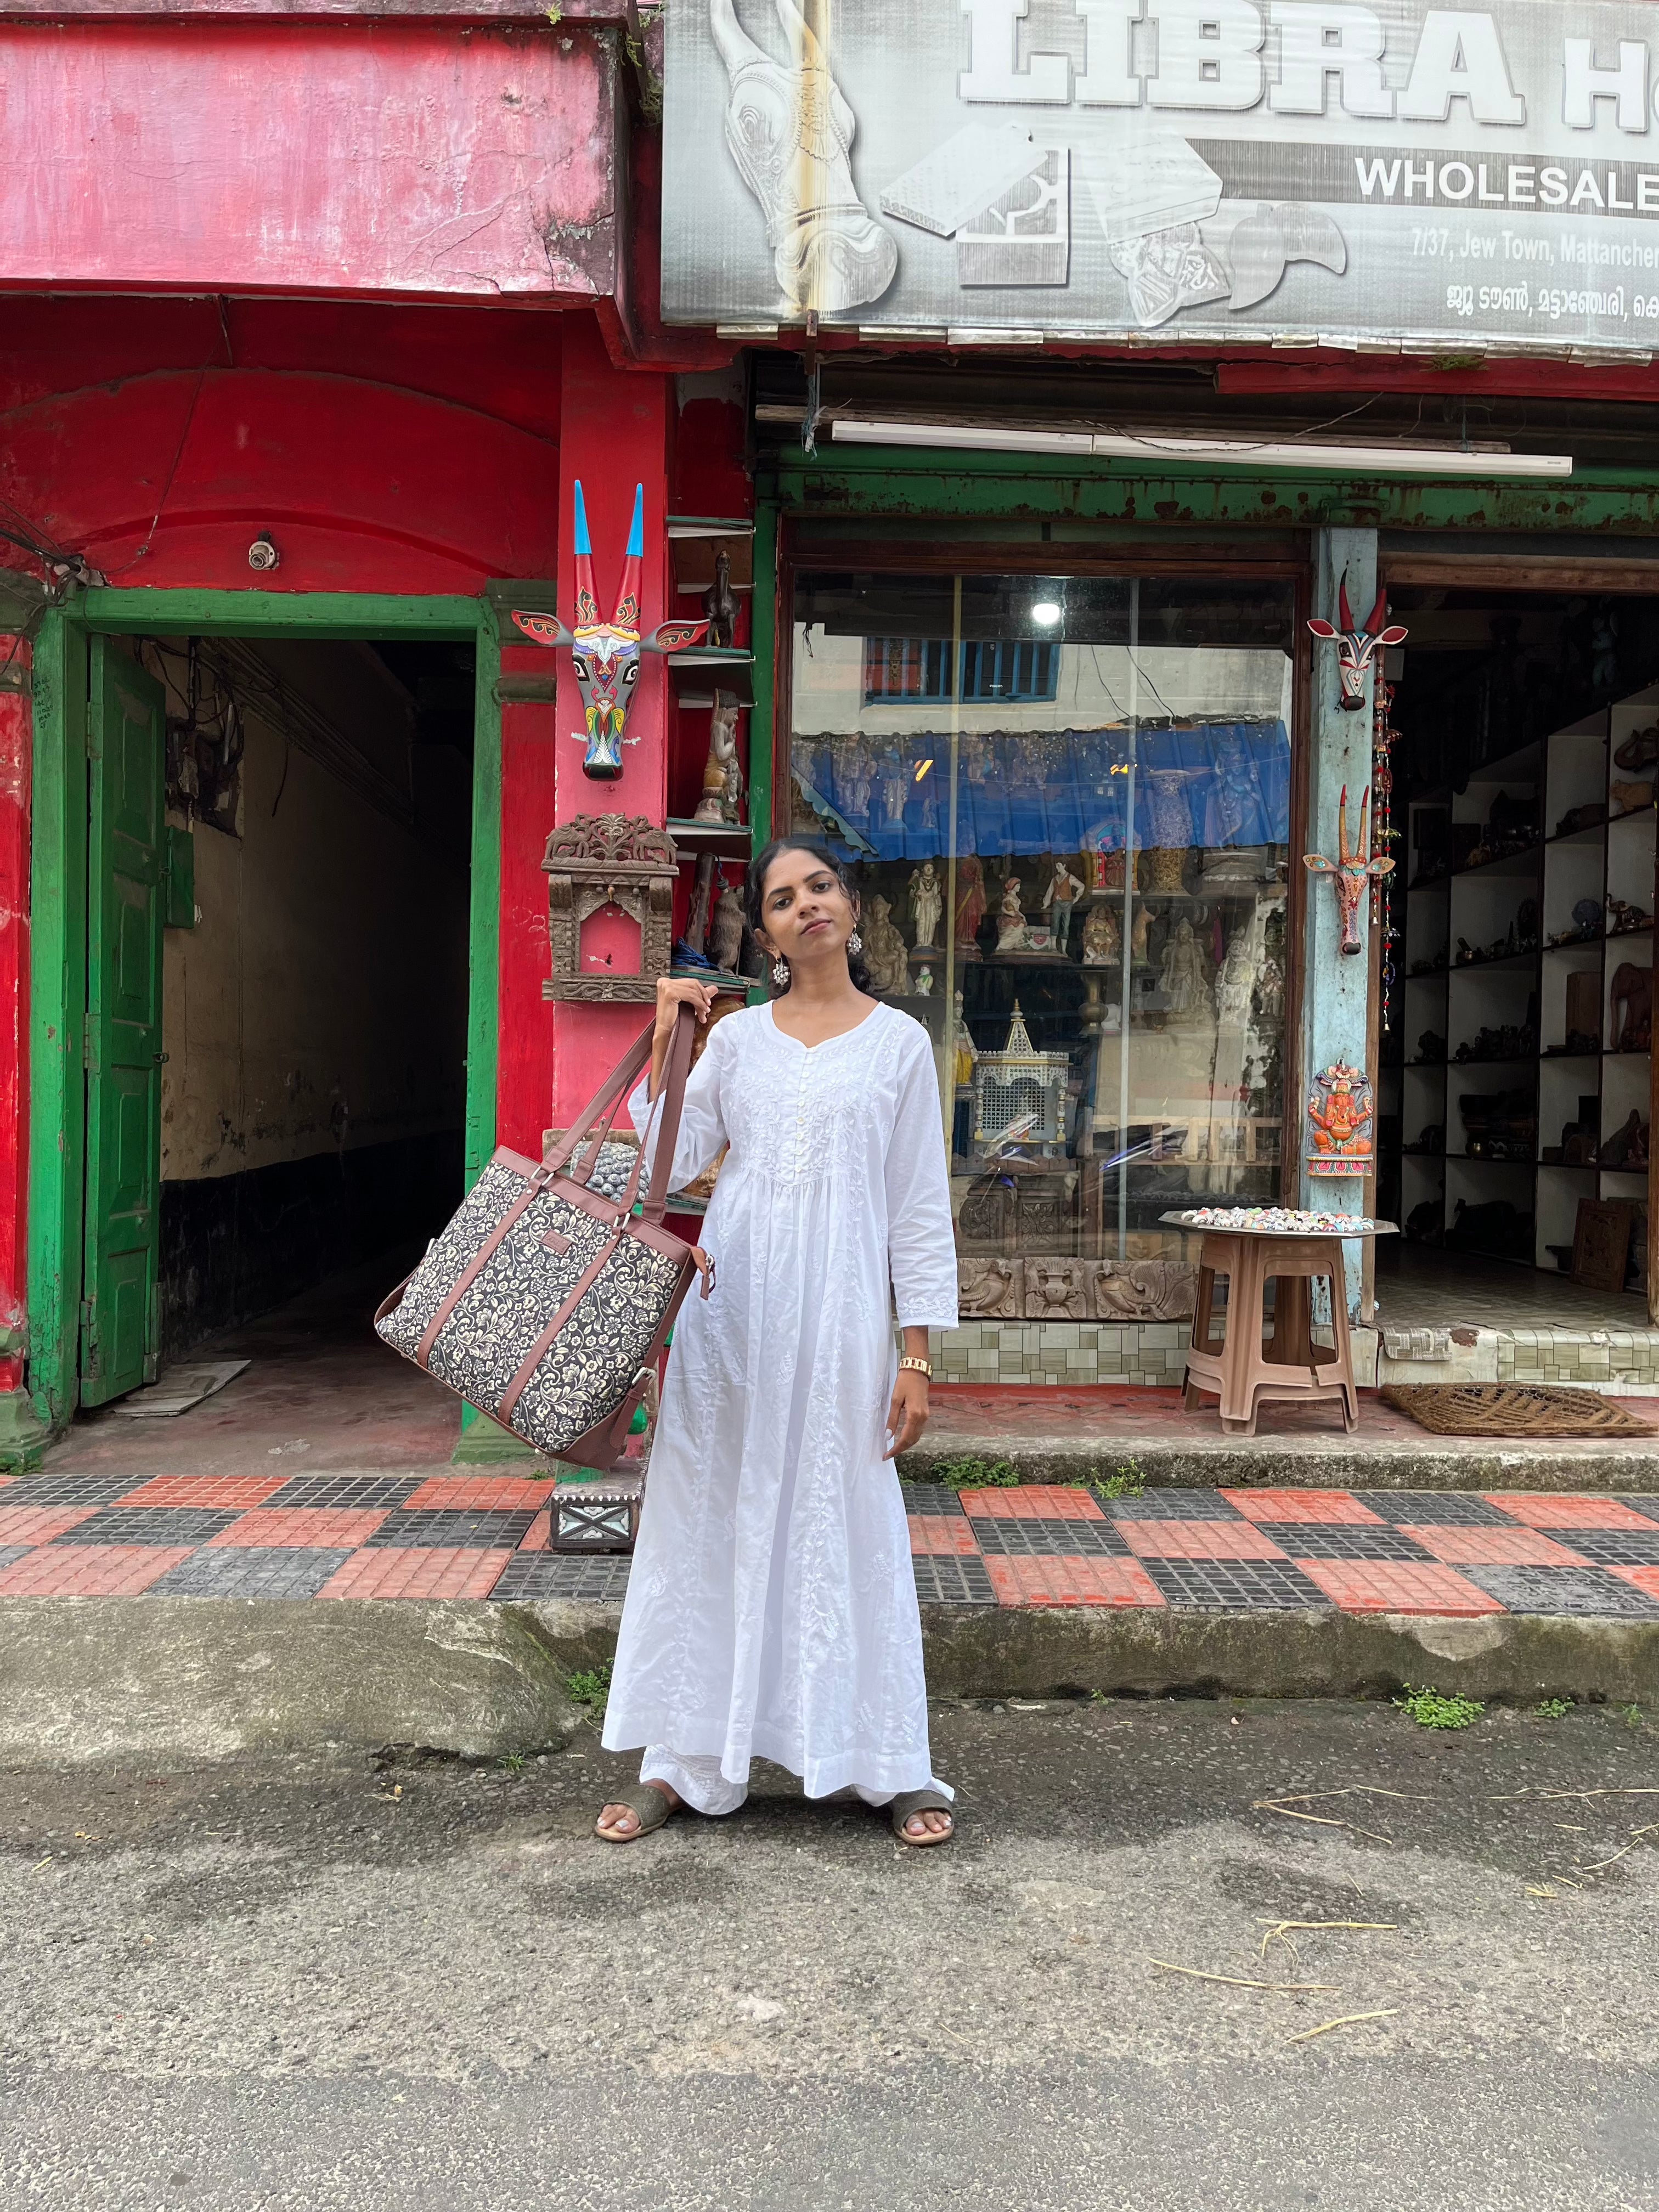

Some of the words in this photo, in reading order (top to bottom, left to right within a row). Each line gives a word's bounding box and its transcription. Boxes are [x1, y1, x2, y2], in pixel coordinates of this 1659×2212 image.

[958, 0, 1525, 124] LIBRA
[1562, 37, 1659, 132] H
[1355, 157, 1659, 212] WHOLESALE
[1412, 227, 1453, 263] 7/37,
[1459, 228, 1496, 258] Jew
[1501, 230, 1554, 267] Town,
